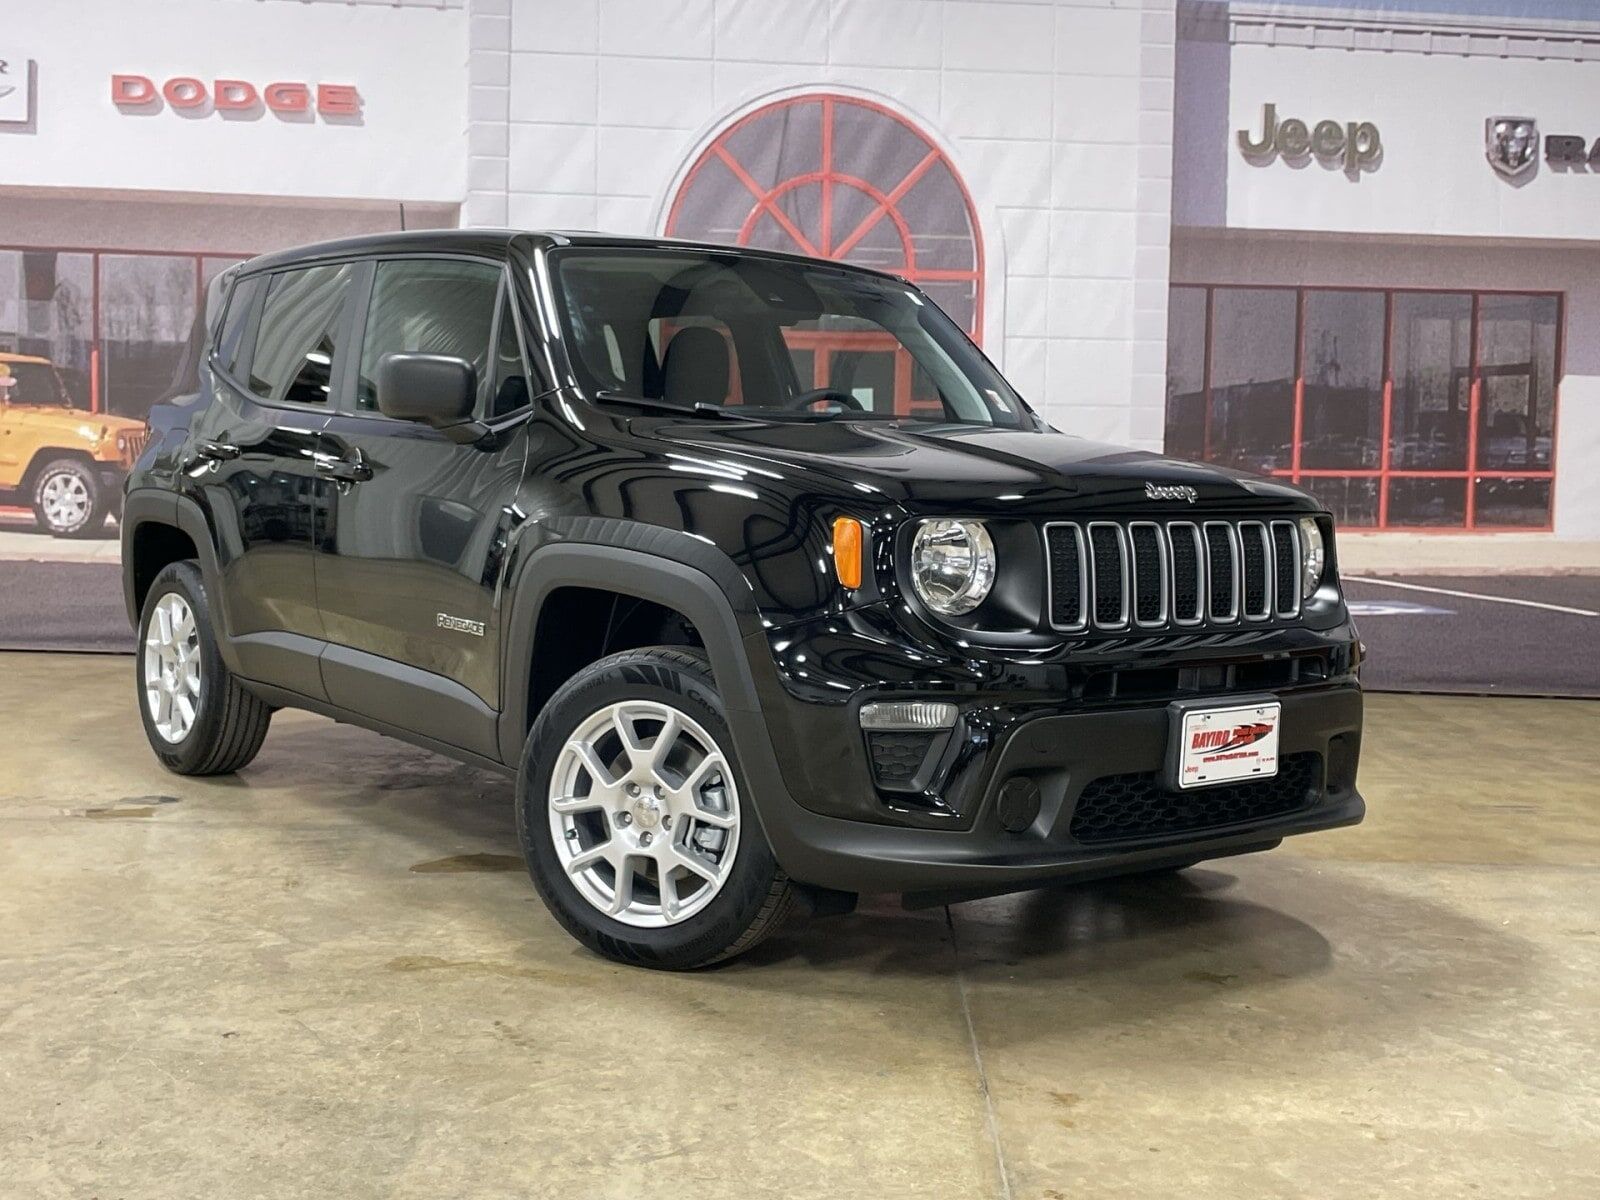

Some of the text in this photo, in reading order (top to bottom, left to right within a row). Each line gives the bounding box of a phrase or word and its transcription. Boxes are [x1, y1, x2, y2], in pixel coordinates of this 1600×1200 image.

[111, 73, 361, 117] DODGE
[1238, 103, 1382, 174] Jeep
[1145, 481, 1199, 504] Jeep
